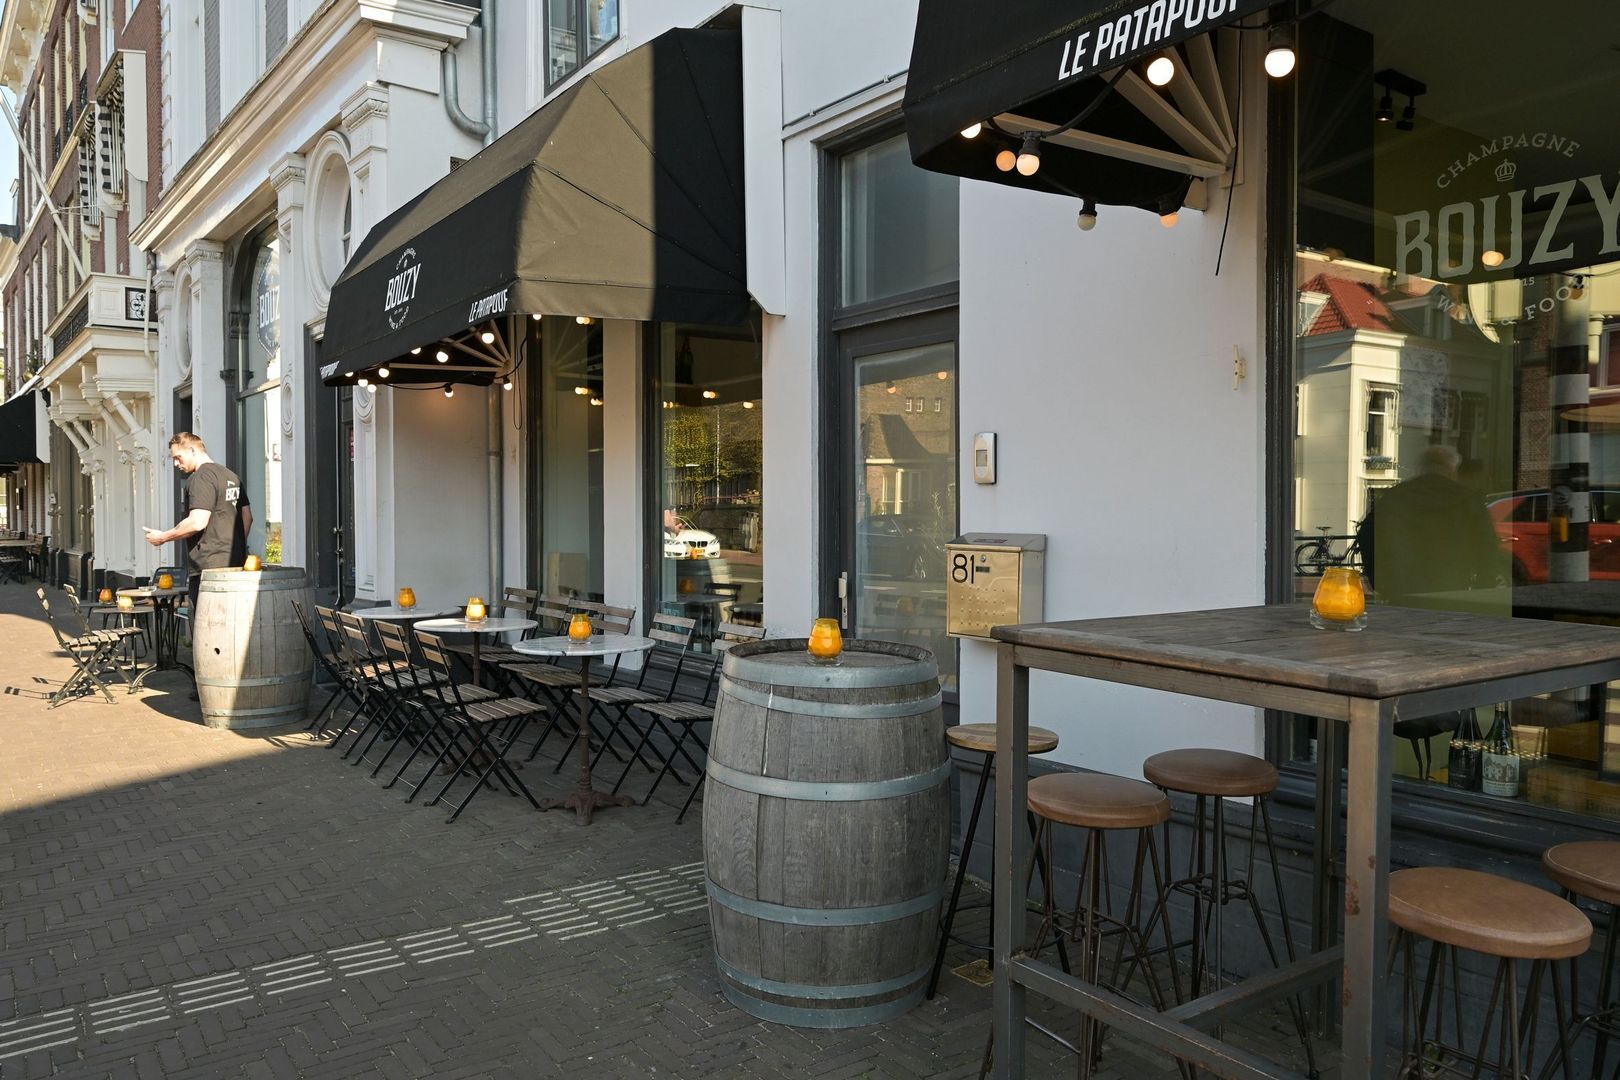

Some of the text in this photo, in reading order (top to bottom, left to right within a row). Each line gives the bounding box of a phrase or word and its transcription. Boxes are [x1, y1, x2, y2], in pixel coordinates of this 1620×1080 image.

[1058, 0, 1237, 81] LE PATAPO
[1436, 132, 1581, 189] CHAMPAGNE
[1393, 171, 1620, 289] BOUZY
[259, 285, 281, 329] BOUZ
[384, 263, 421, 311] BOUZY
[1525, 275, 1586, 320] FOO
[952, 553, 975, 584] 81
